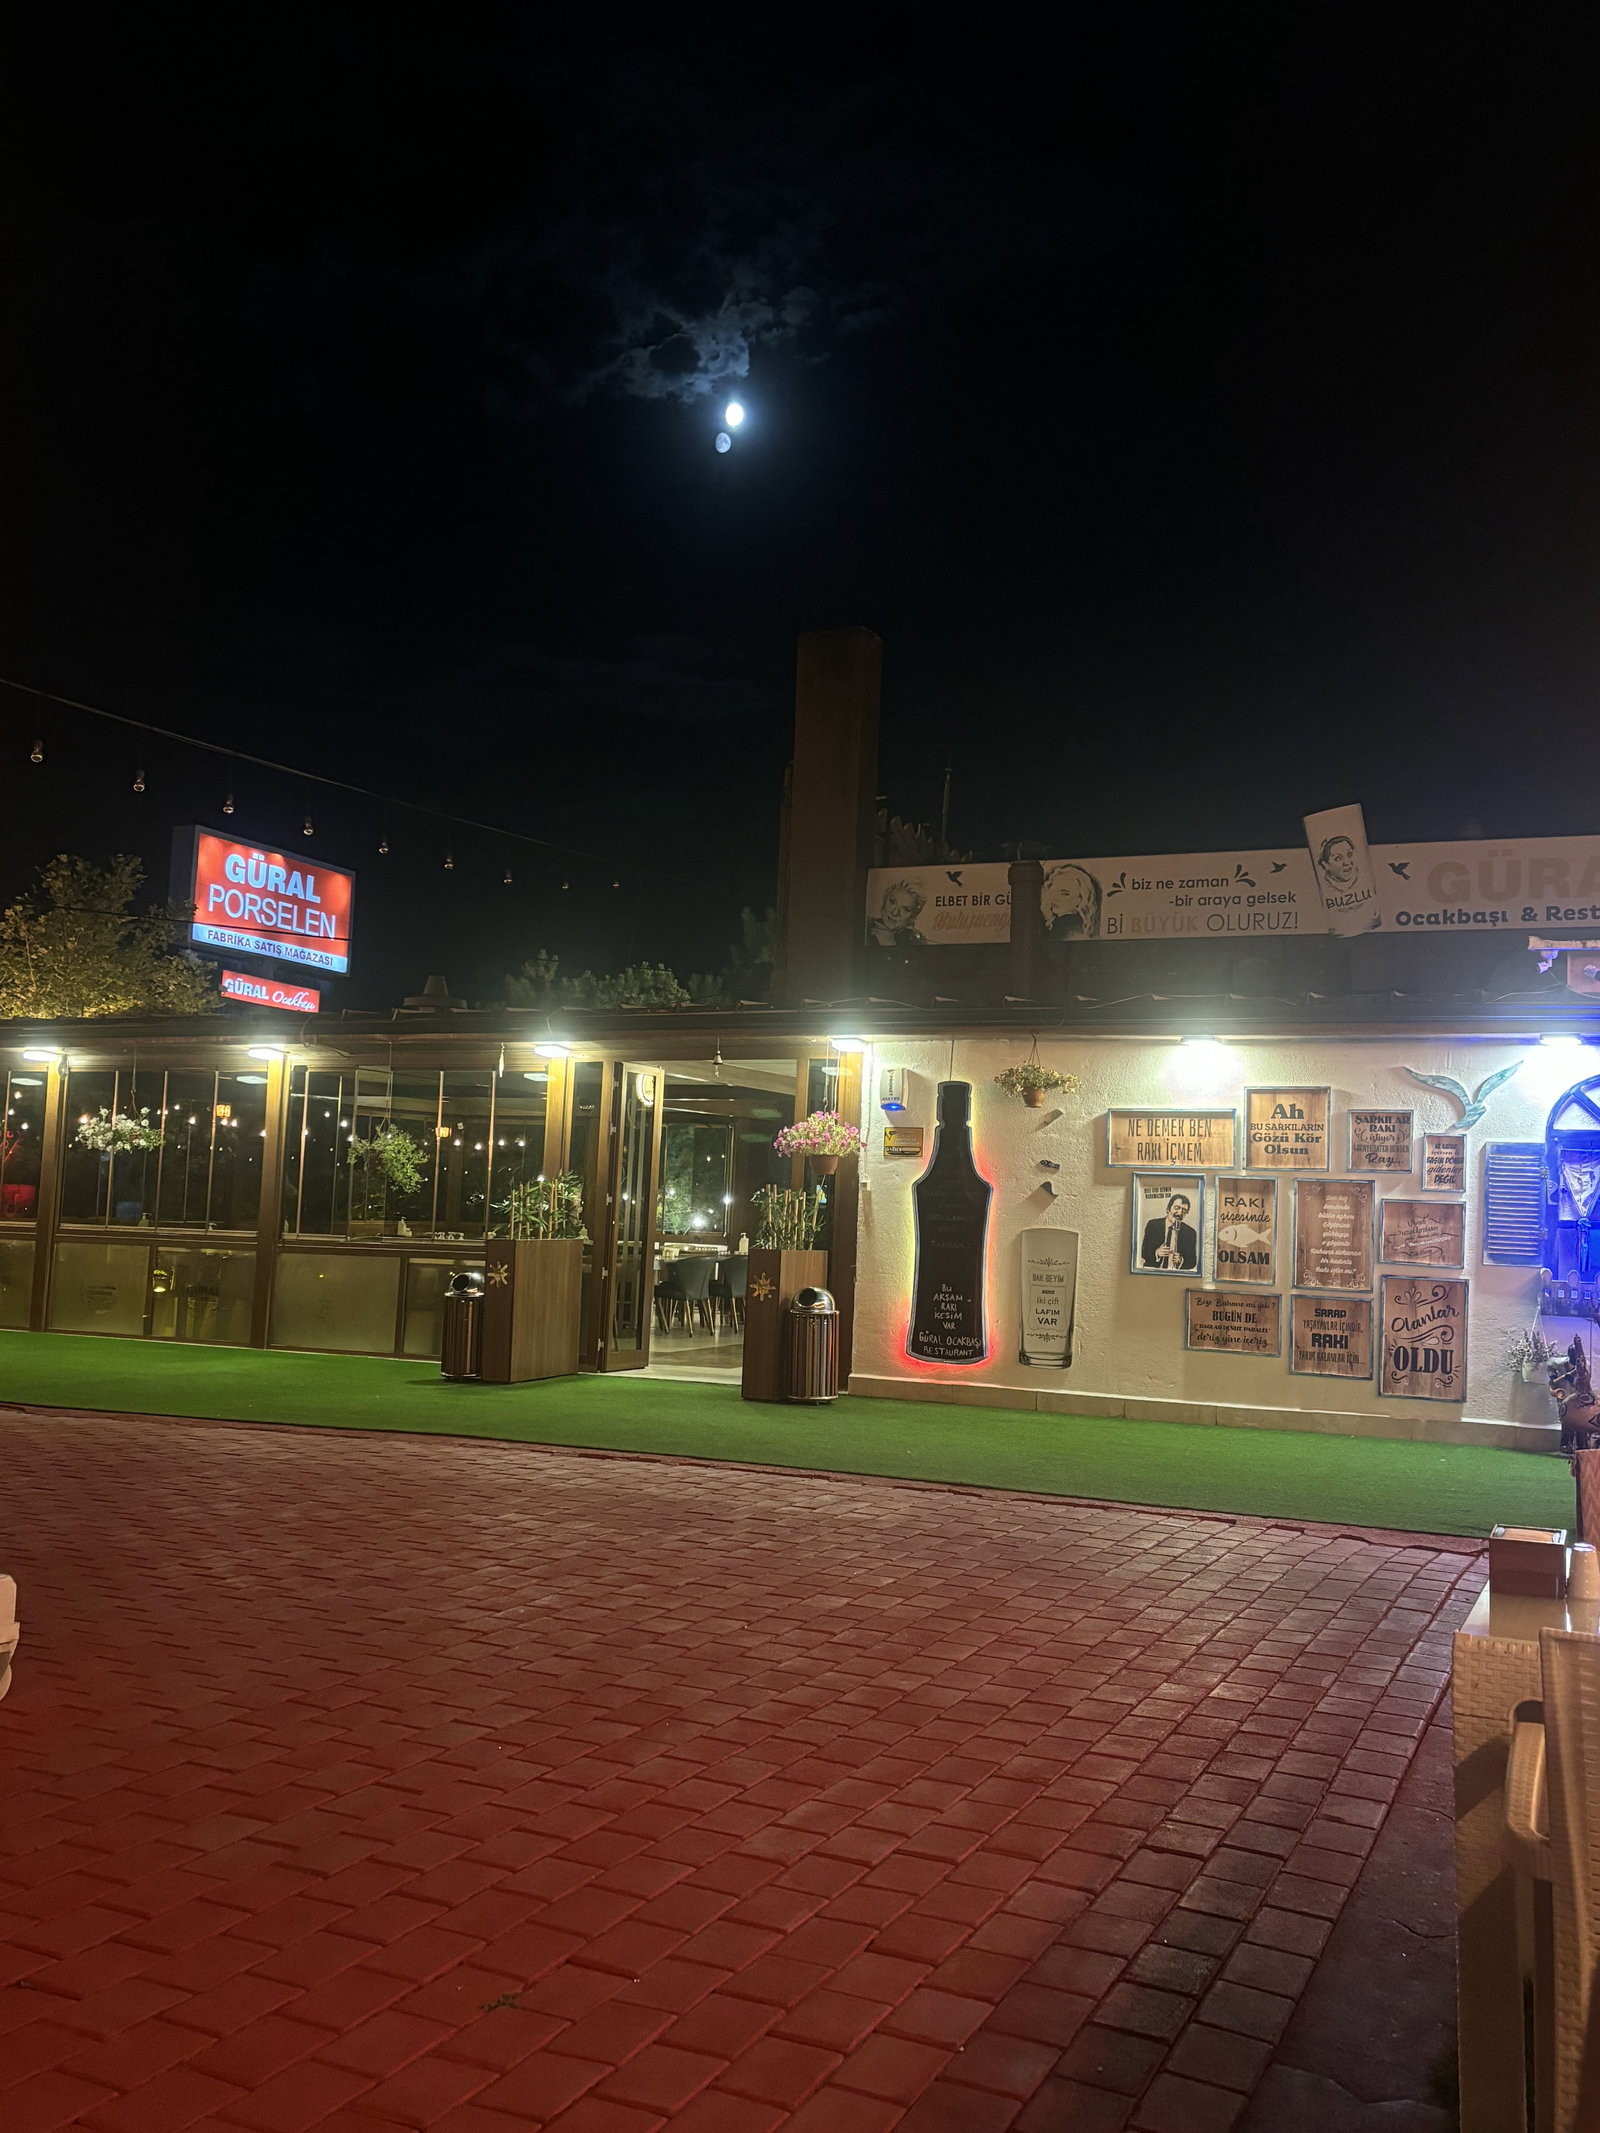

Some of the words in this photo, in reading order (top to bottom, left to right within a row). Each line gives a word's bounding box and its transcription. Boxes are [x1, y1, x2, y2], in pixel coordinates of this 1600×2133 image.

[225, 852, 321, 903] GÜRAL
[1131, 875, 1152, 890] biz
[1156, 878, 1174, 890] ne
[1178, 876, 1229, 889] zaman
[935, 896, 968, 907] ELBET
[972, 892, 991, 906] BİR
[1197, 893, 1242, 909] araya
[1246, 890, 1297, 908] gelsek
[1326, 889, 1371, 909] BUZLU
[208, 884, 336, 940] PORSELEN
[1395, 908, 1509, 927] Ocakbaşı
[1521, 905, 1538, 922] &
[1545, 903, 1600, 921] Rest
[1106, 912, 1124, 934] Bİ
[1131, 910, 1199, 933] BÜYÜK
[1206, 909, 1299, 932] OLURUZ!
[207, 930, 251, 948] FABRİKA
[254, 940, 282, 955] SATIŞ
[285, 947, 333, 966] MAĞAZASI
[224, 978, 269, 1000] GÜRAL
[1270, 1103, 1305, 1120] Ah
[1128, 1118, 1142, 1137] NE
[1147, 1118, 1185, 1137] DEMEK
[1189, 1118, 1212, 1138] BEN
[1250, 1123, 1263, 1131] BU
[1369, 1125, 1396, 1133] RAKI
[1252, 1132, 1289, 1144] Gözü
[1294, 1132, 1322, 1144] Kör
[1137, 1142, 1161, 1161] RAKI
[1165, 1138, 1203, 1166] İÇMEM
[1264, 1144, 1309, 1155] Olsun
[1224, 1197, 1265, 1209] RAKI
[1220, 1211, 1271, 1223] şişesinde
[1218, 1251, 1270, 1265] OLSAM
[1032, 1273, 1043, 1282] BAK
[1046, 1274, 1064, 1283] BEYİM
[941, 1303, 957, 1311] RAKI
[1035, 1308, 1060, 1316] LAFIM
[1037, 1317, 1057, 1325] VAR
[1212, 1310, 1242, 1323] BUGÜN
[1245, 1312, 1257, 1324] DE
[1391, 1303, 1460, 1333] Olanlar
[942, 1321, 956, 1330] VAR
[1197, 1332, 1220, 1344] deriz
[1312, 1333, 1349, 1349] RAKI
[1393, 1345, 1454, 1374] OLDU
